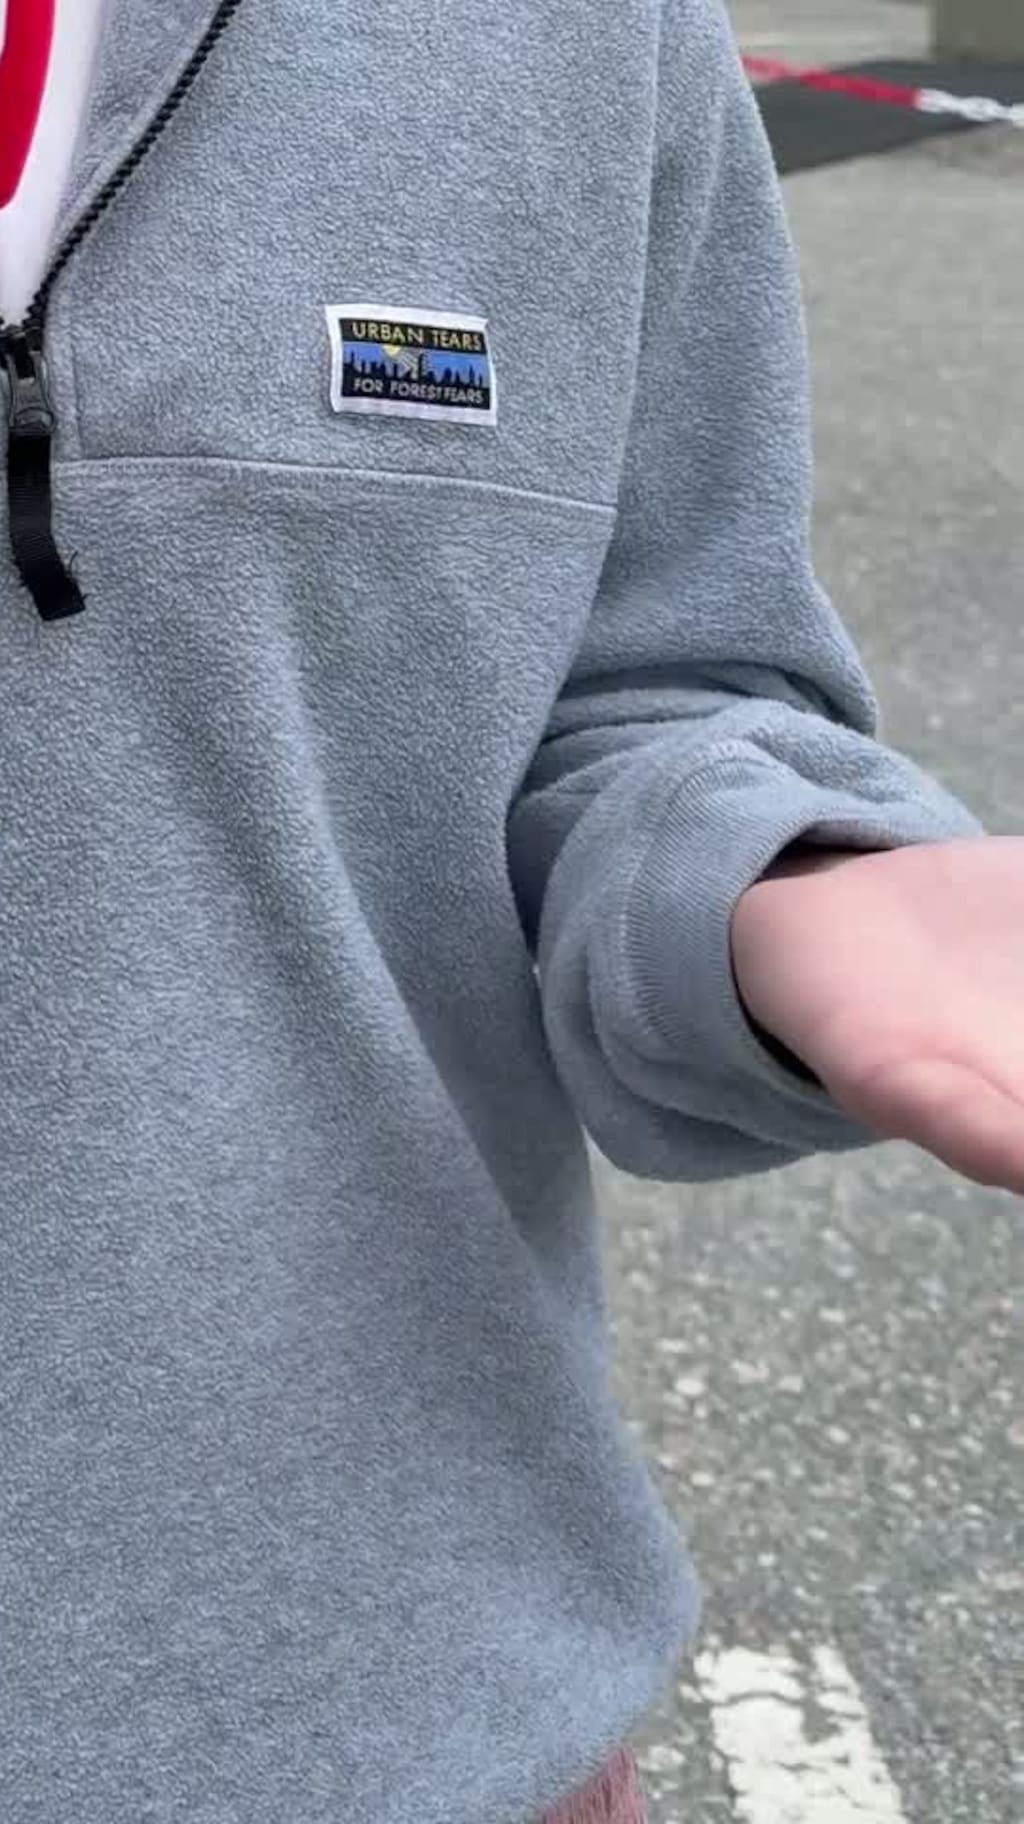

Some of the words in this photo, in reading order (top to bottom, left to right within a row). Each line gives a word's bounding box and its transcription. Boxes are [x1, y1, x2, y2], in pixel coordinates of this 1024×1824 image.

[352, 321, 424, 344] URBAN
[431, 330, 481, 351] TEARS
[353, 377, 383, 393] FOR
